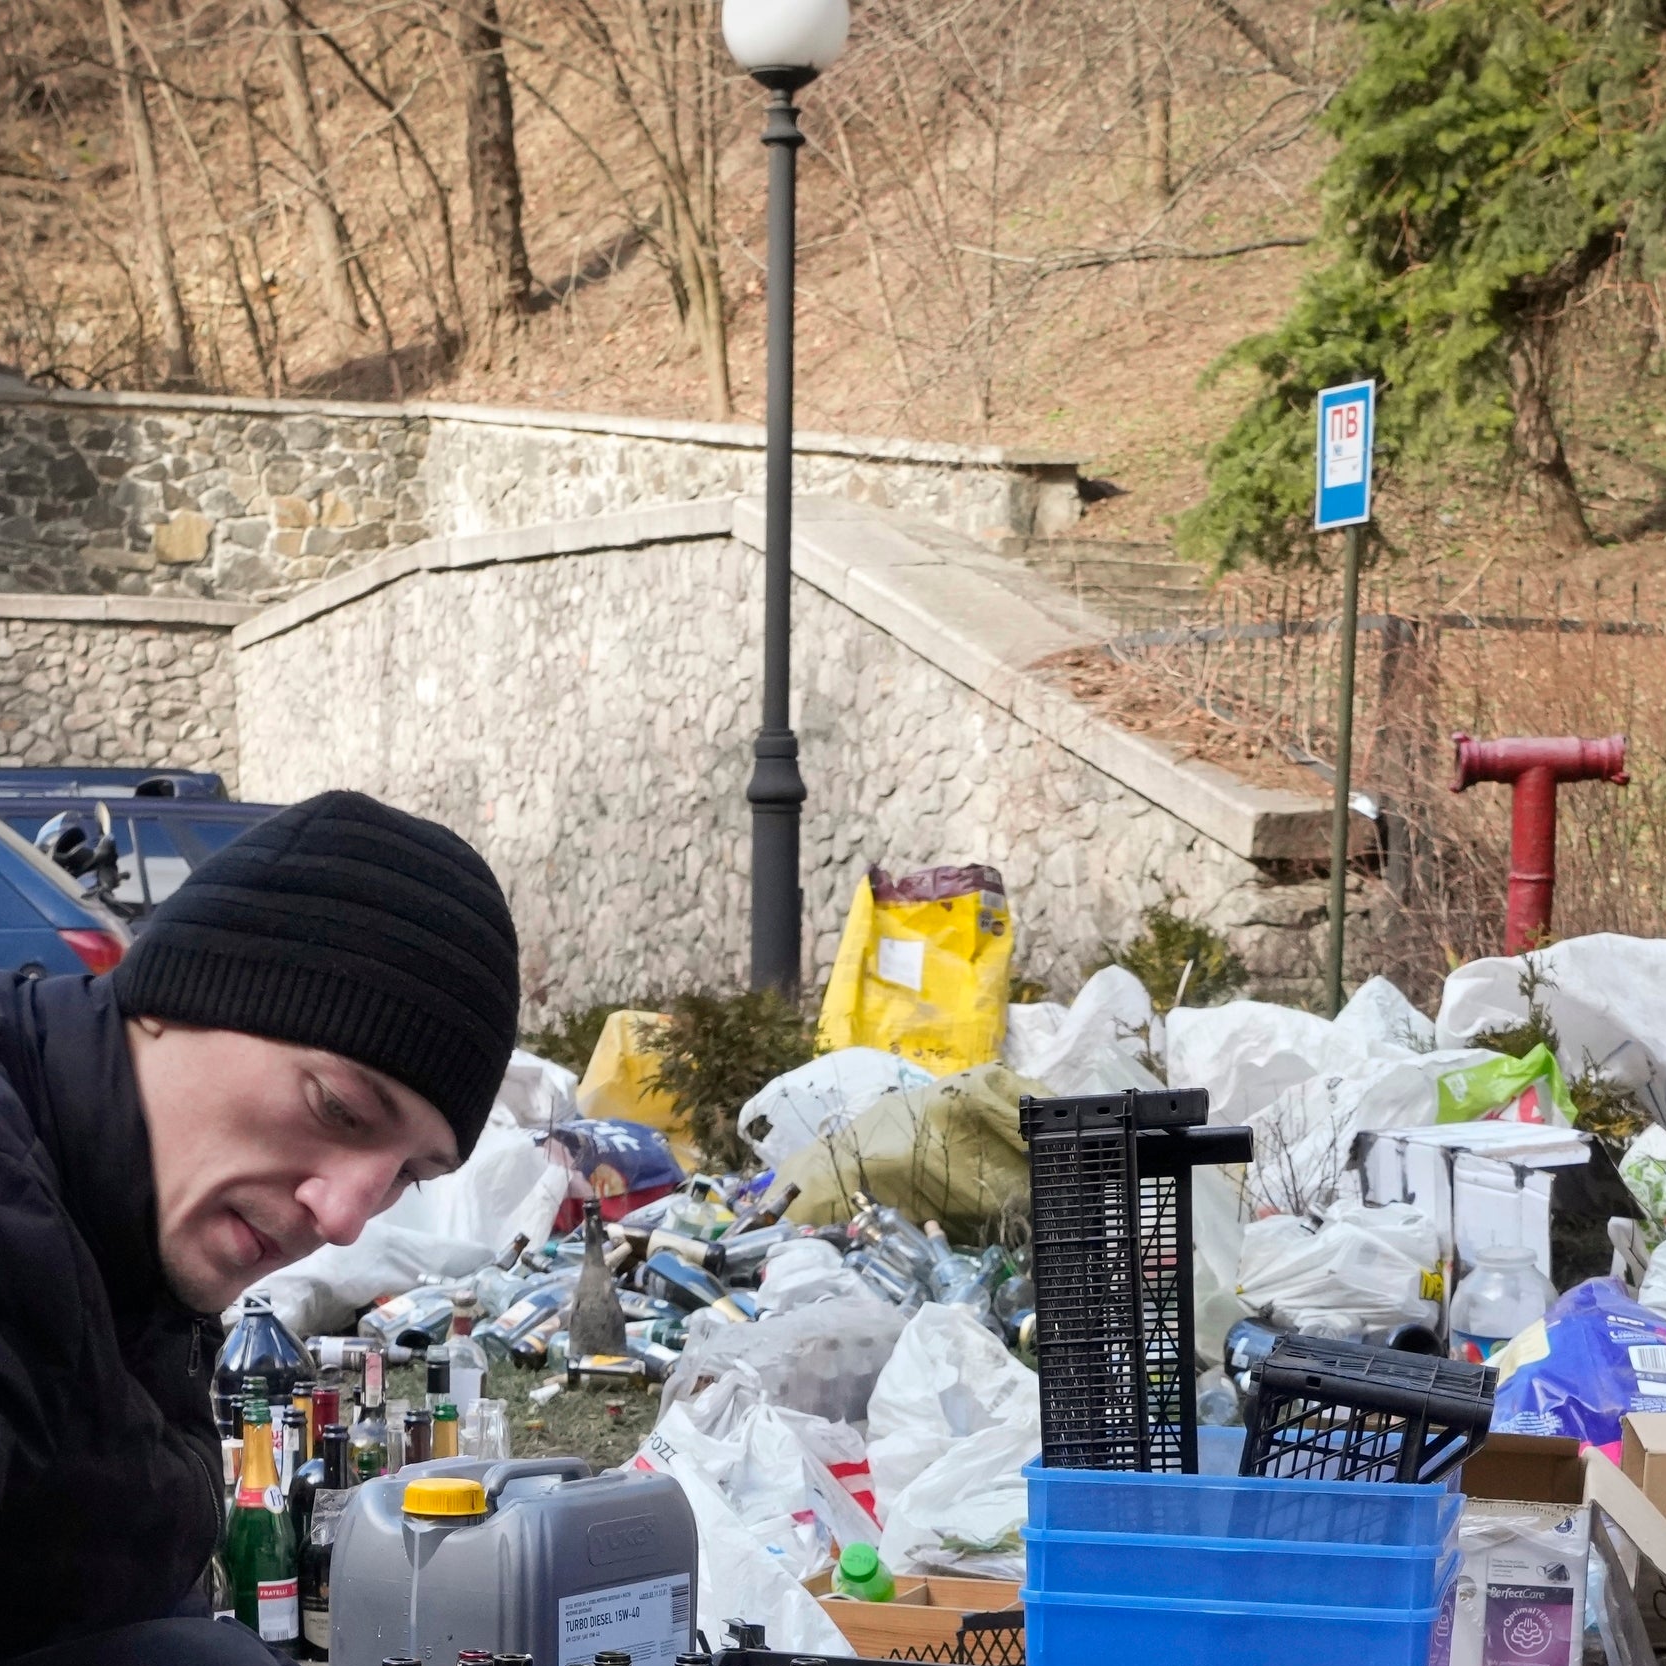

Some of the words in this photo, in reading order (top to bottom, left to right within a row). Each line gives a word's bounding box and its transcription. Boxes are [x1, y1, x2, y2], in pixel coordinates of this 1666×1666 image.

[259, 1588, 288, 1597] FRATELLI
[1489, 1587, 1545, 1600] PerfectCare
[566, 1617, 588, 1633] TURBO
[590, 1612, 613, 1628] DIESEL
[615, 1606, 640, 1623] 15W-40
